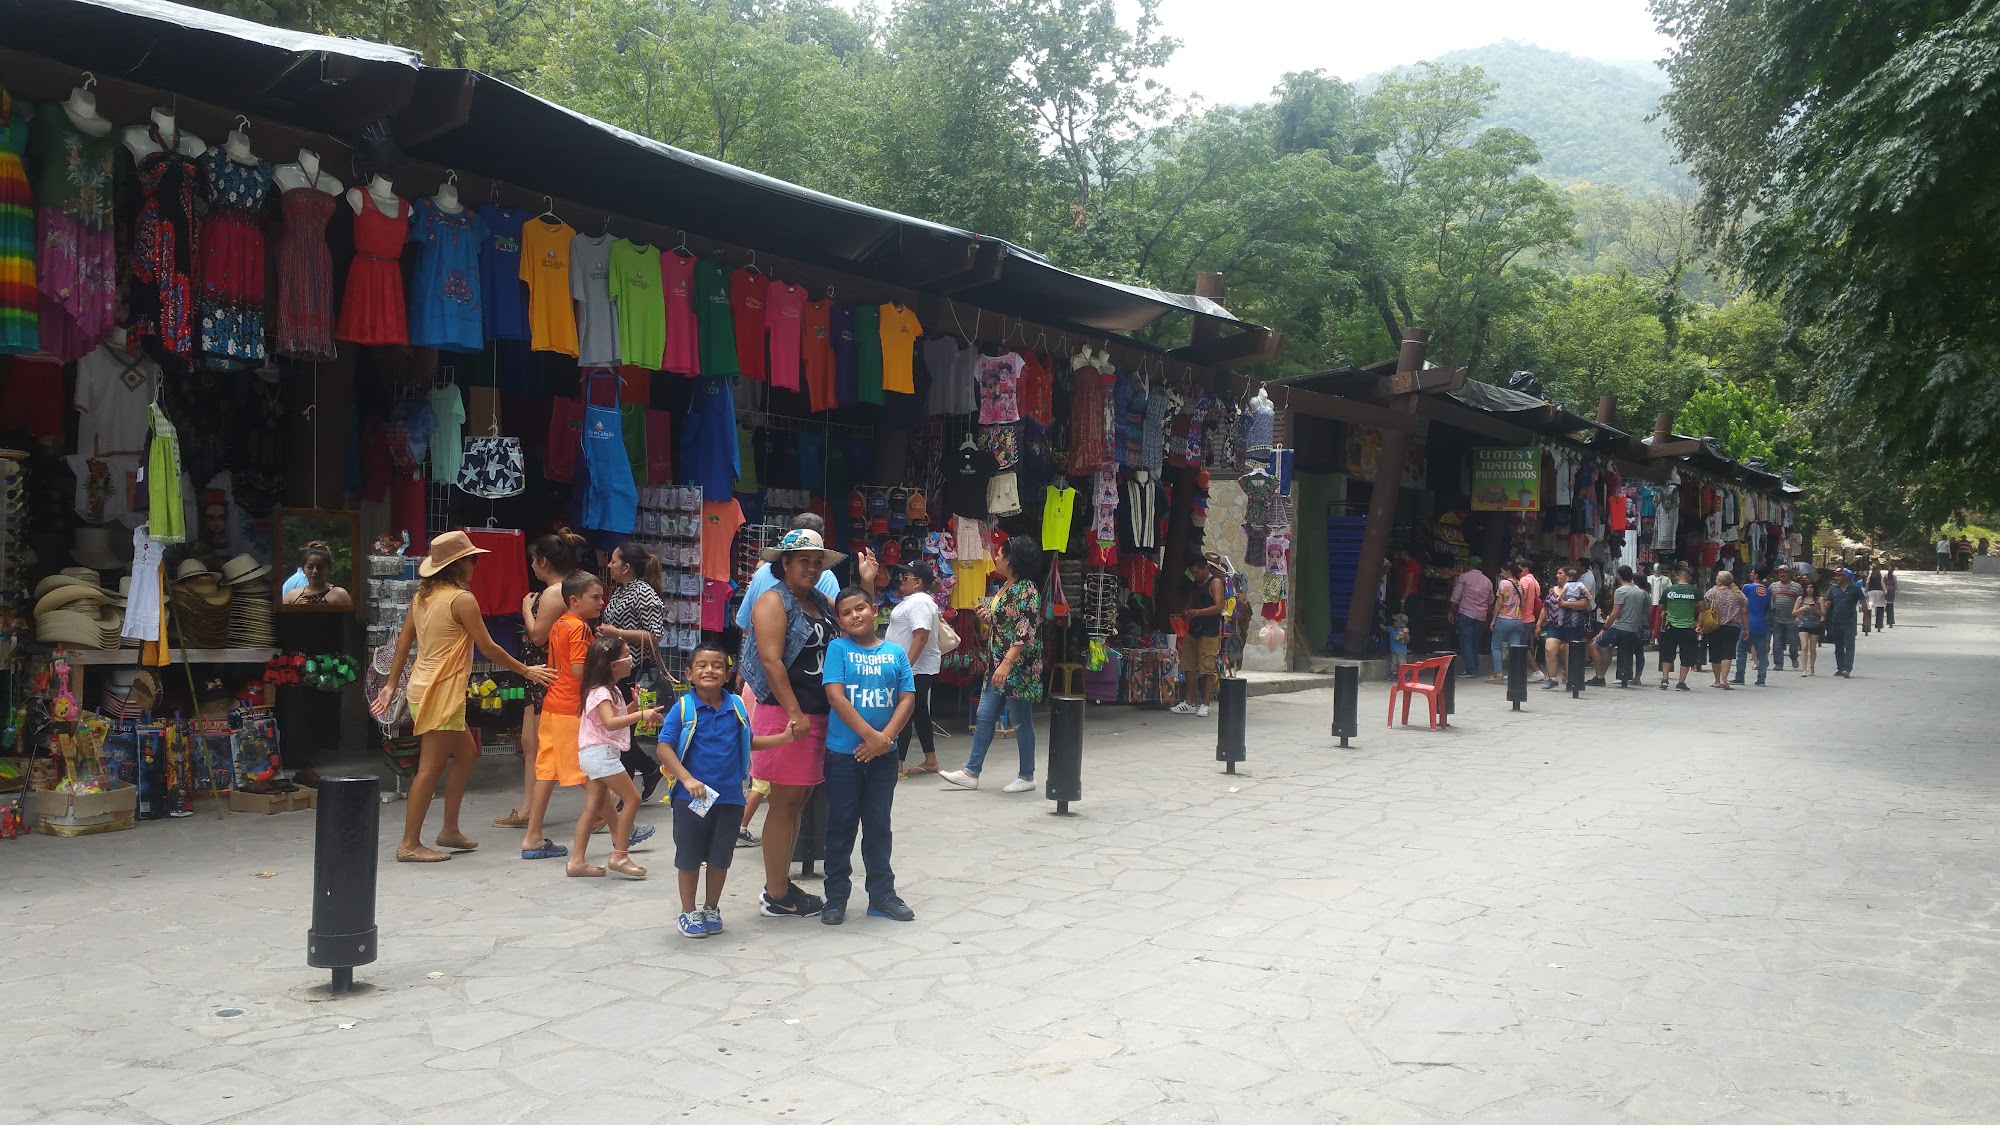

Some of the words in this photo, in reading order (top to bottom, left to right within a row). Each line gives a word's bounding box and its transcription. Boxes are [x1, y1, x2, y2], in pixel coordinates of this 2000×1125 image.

[1480, 450, 1523, 460] ELOTES
[1526, 450, 1534, 459] Y
[1481, 461, 1533, 470] TOSTITOS
[1475, 470, 1537, 479] PREPARADOS
[1667, 591, 1695, 600] Corona
[848, 652, 895, 666] TOUGHER
[855, 663, 882, 676] THAN
[846, 684, 896, 708] T-REX
